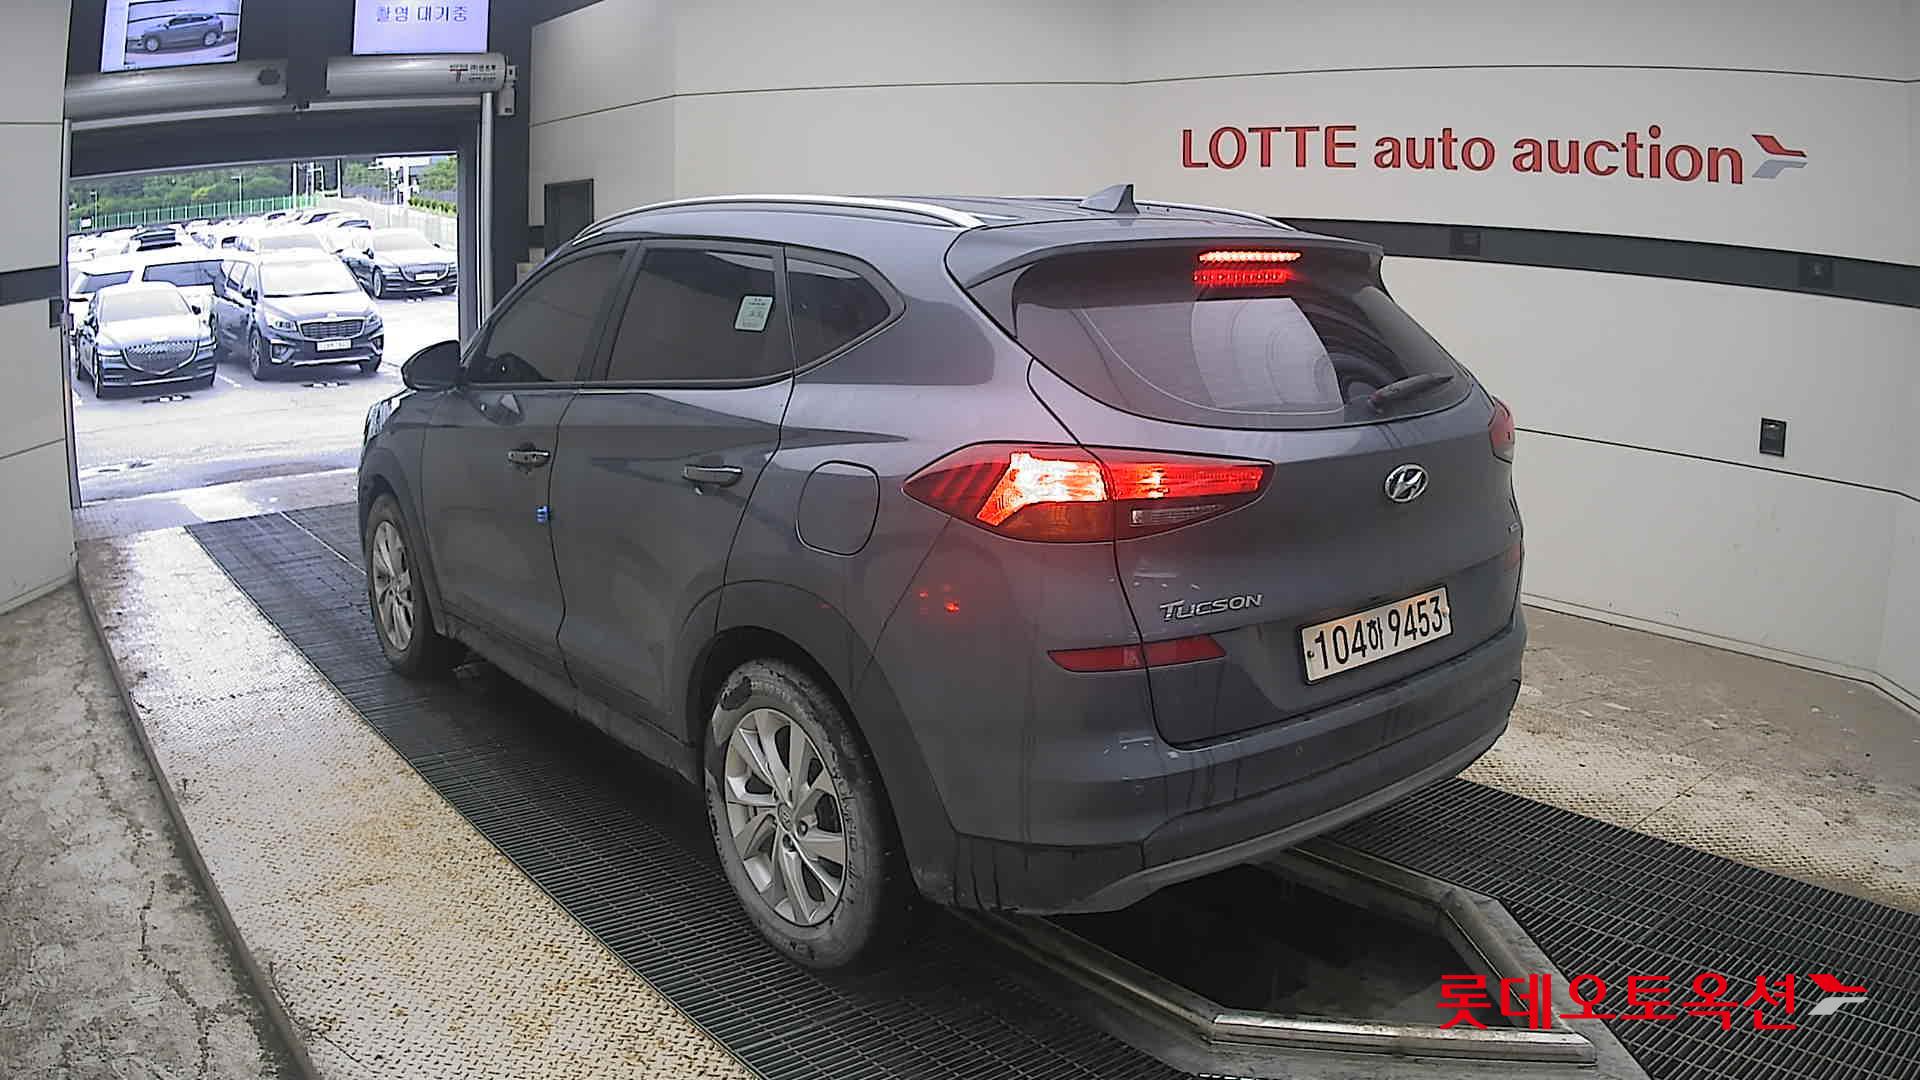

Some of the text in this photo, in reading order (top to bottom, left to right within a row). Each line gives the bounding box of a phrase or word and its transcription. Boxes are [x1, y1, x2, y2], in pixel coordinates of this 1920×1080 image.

[417, 5, 467, 22] 대기중
[1182, 124, 1743, 185] LOTTE auto auction
[1159, 593, 1263, 620] TUCSON
[1314, 595, 1443, 670] 104하 9453
